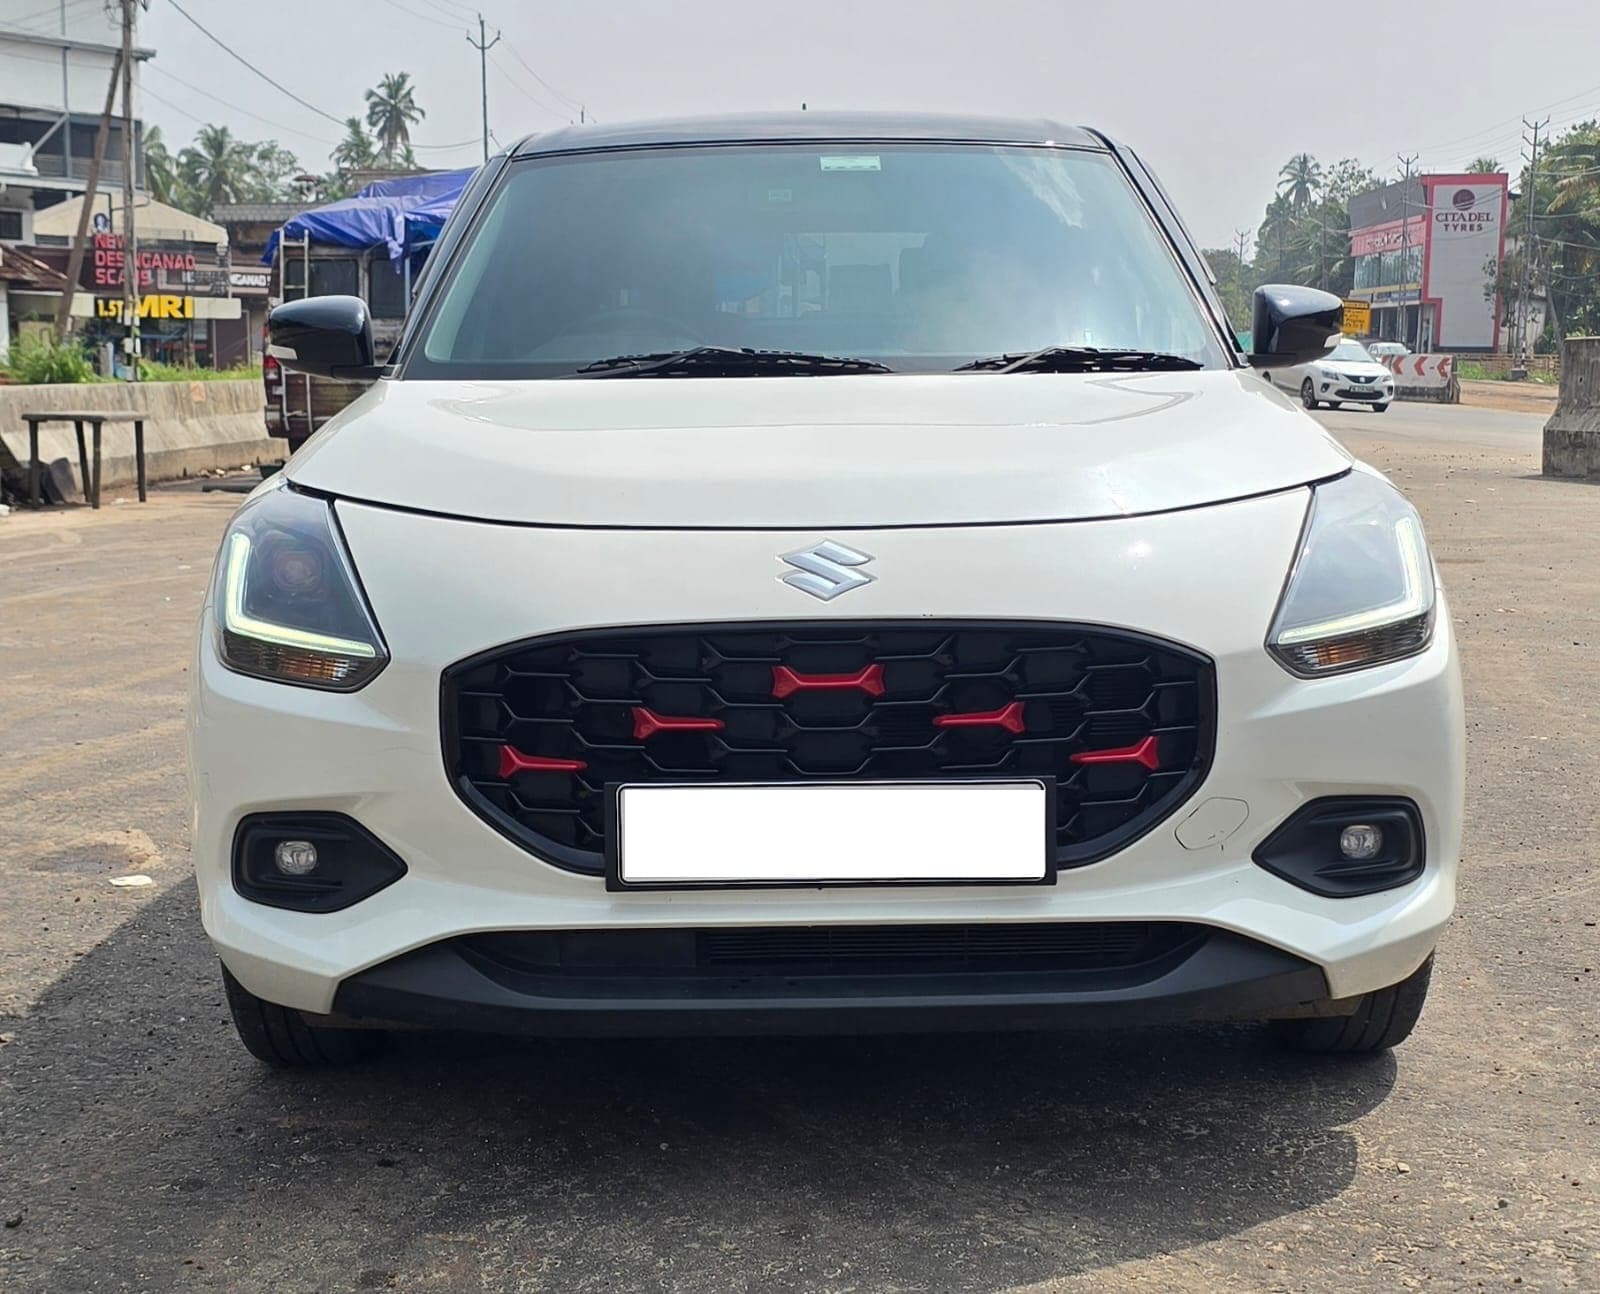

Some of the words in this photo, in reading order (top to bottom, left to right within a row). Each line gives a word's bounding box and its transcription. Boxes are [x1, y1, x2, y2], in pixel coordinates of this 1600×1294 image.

[1435, 212, 1494, 223] CITADEL
[1443, 223, 1484, 232] TYRES
[135, 294, 194, 319] MRI
